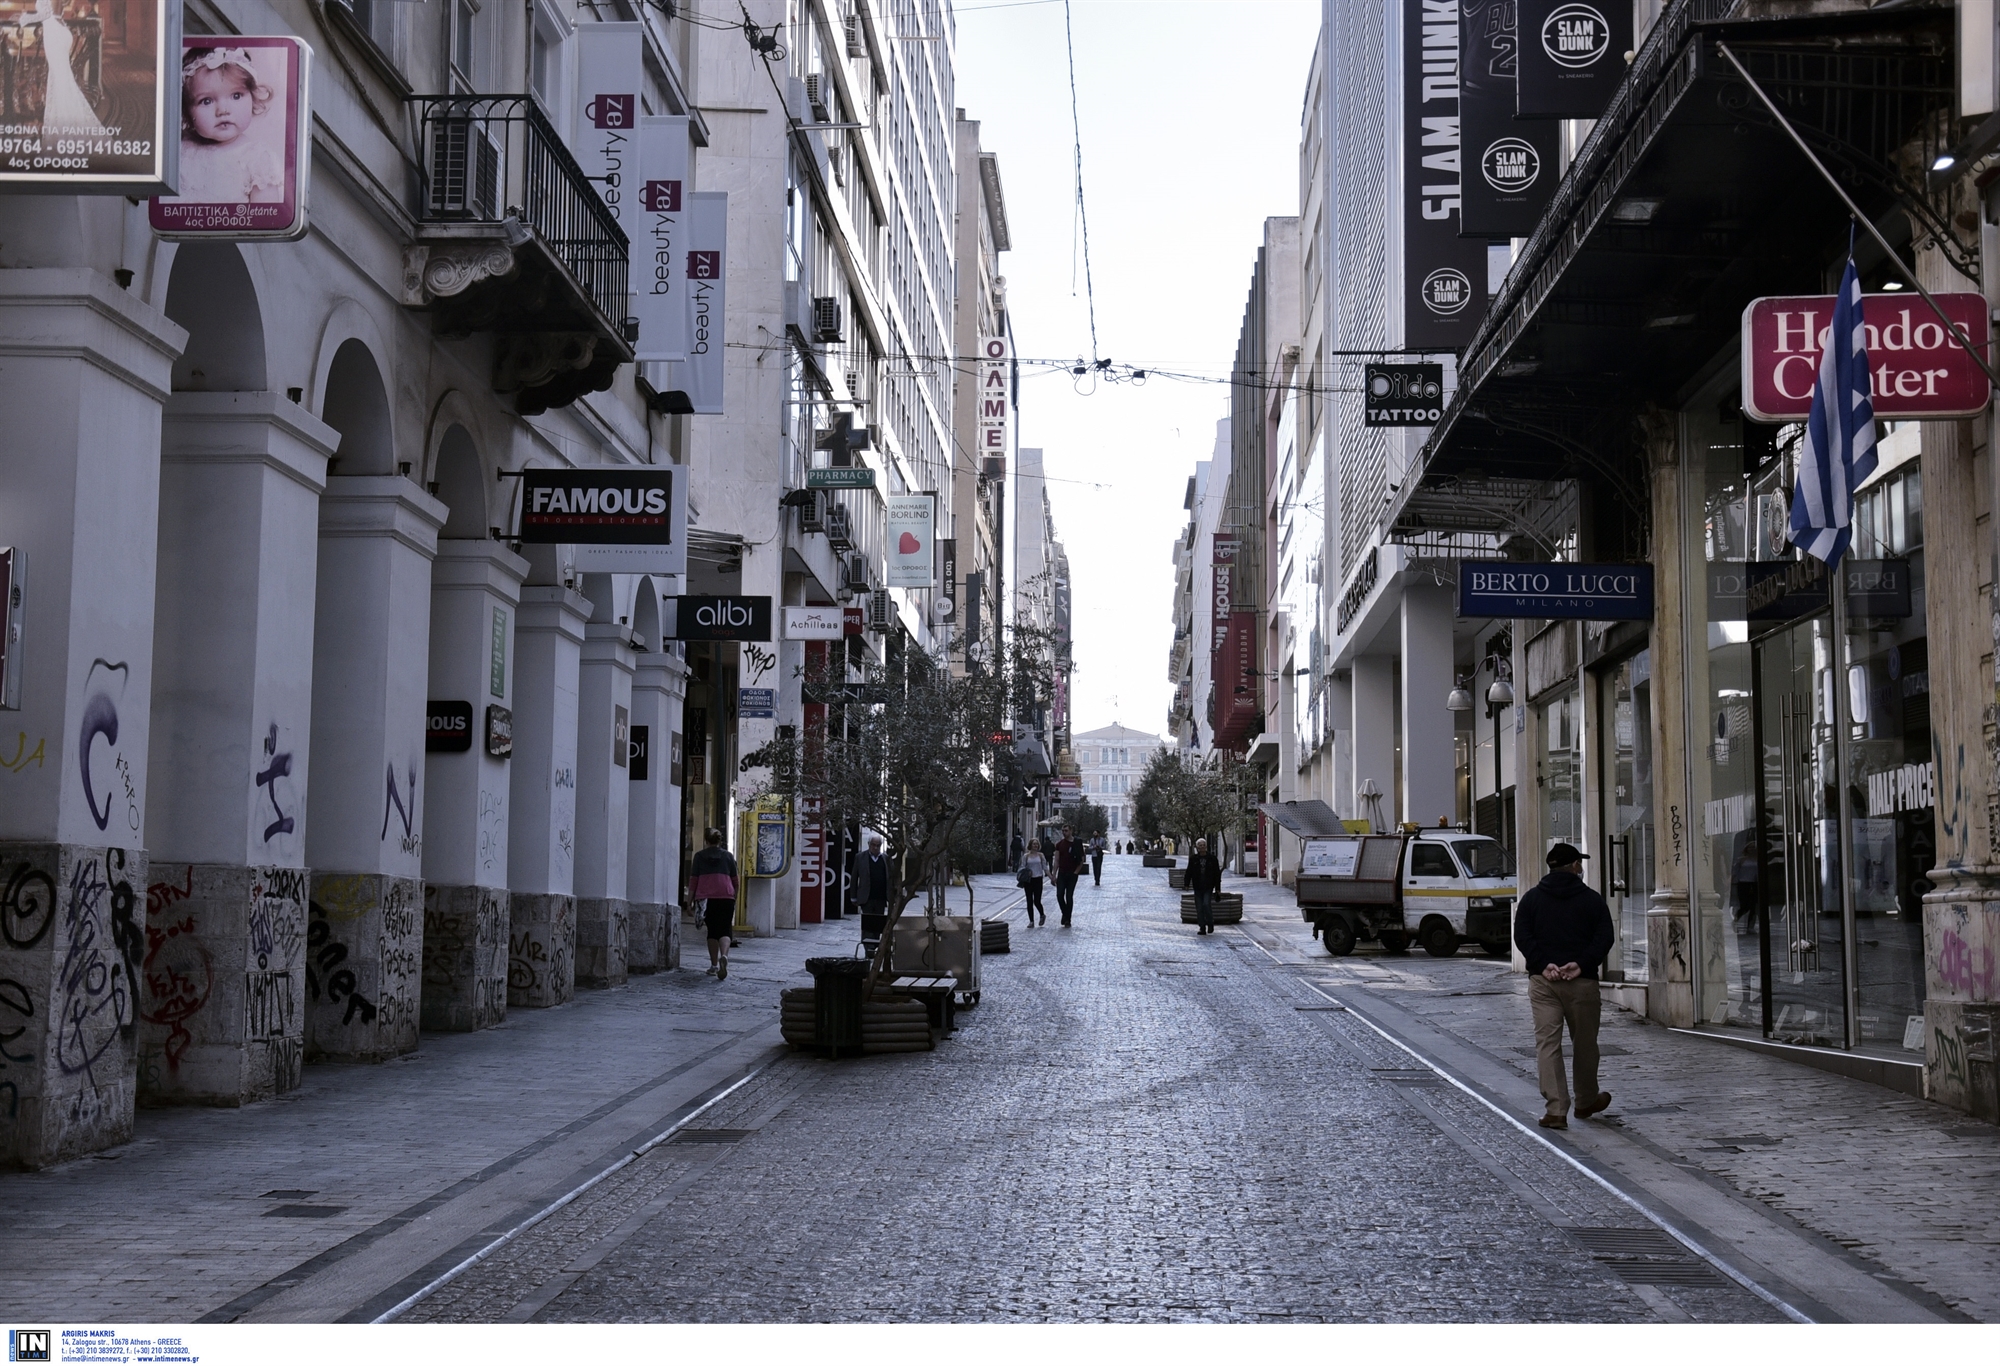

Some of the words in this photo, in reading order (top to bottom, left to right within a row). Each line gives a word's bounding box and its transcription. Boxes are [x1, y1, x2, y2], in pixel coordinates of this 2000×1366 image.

[1557, 20, 1594, 37] SLAM
[1558, 36, 1594, 51] DUNK
[606, 97, 624, 127] az
[41, 126, 60, 136] ΓΙΑ
[62, 126, 122, 137] ΡΑΝΤΕΒΟΥ
[56, 140, 150, 156] 6951416382
[8, 157, 31, 170] 4ος
[33, 157, 89, 169] ΟΡΟΦΟΣ
[1496, 151, 1527, 165] SLAM
[600, 131, 628, 220] eauty
[1496, 165, 1527, 179] DUNK
[656, 182, 672, 210] az
[164, 206, 229, 217] ΒΑΠΤΙΣΤΙΚΑ
[185, 217, 204, 229] 4ος
[206, 216, 253, 227] ΟΡΟΦΟΣ
[649, 213, 676, 295] beauty
[696, 253, 711, 277] az
[1433, 280, 1460, 292] SLAM
[1433, 291, 1460, 303] DUNK
[691, 281, 715, 355] beauty
[1773, 355, 1949, 400] Cter
[1368, 408, 1441, 421] TATTOO
[809, 471, 872, 480] PHARMACY
[532, 487, 667, 515] FAMOUS
[532, 516, 584, 524] shoes
[598, 516, 659, 524] stores
[945, 560, 954, 577] too
[945, 578, 954, 595] tall
[1471, 572, 1550, 593] BERTO
[1516, 598, 1595, 608] MILANO
[696, 599, 753, 627] alibi
[711, 628, 736, 636] bags
[791, 621, 838, 629] Achilleas
[1867, 767, 1896, 817] HALF
